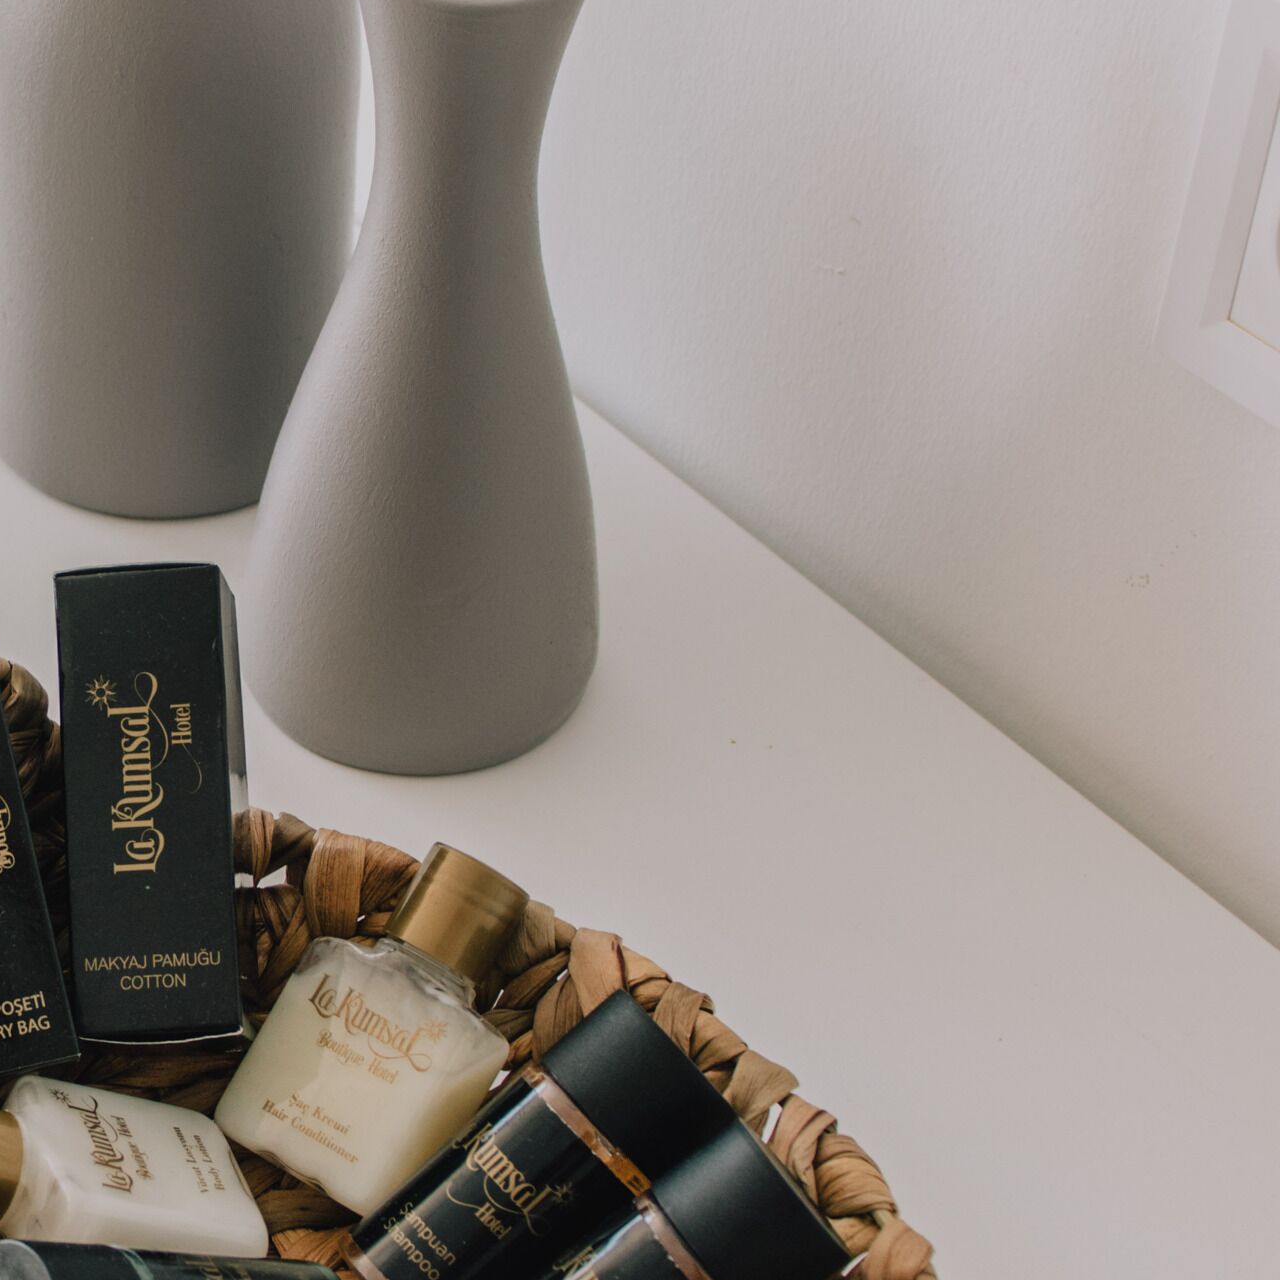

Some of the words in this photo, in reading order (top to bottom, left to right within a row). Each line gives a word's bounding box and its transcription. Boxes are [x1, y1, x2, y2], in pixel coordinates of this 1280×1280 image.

[107, 671, 168, 831] Kumsal
[170, 703, 192, 745] Hotel
[113, 827, 164, 874] La
[84, 954, 148, 972] MAKYAJ
[152, 947, 221, 968] PAMUĞU
[120, 973, 187, 991] COTTON
[17, 1014, 51, 1036] BAG
[308, 973, 337, 1019] La
[337, 987, 433, 1072] Kumsal
[316, 1030, 364, 1066] Boutique
[368, 1059, 400, 1085] Hotel
[67, 1095, 124, 1174] Kumsal
[261, 1099, 289, 1122] Hair
[291, 1114, 359, 1165] Conditioner
[463, 1122, 553, 1232] Kumsal
[476, 1201, 512, 1240] Hotel
[384, 1217, 440, 1280] Shampoo
